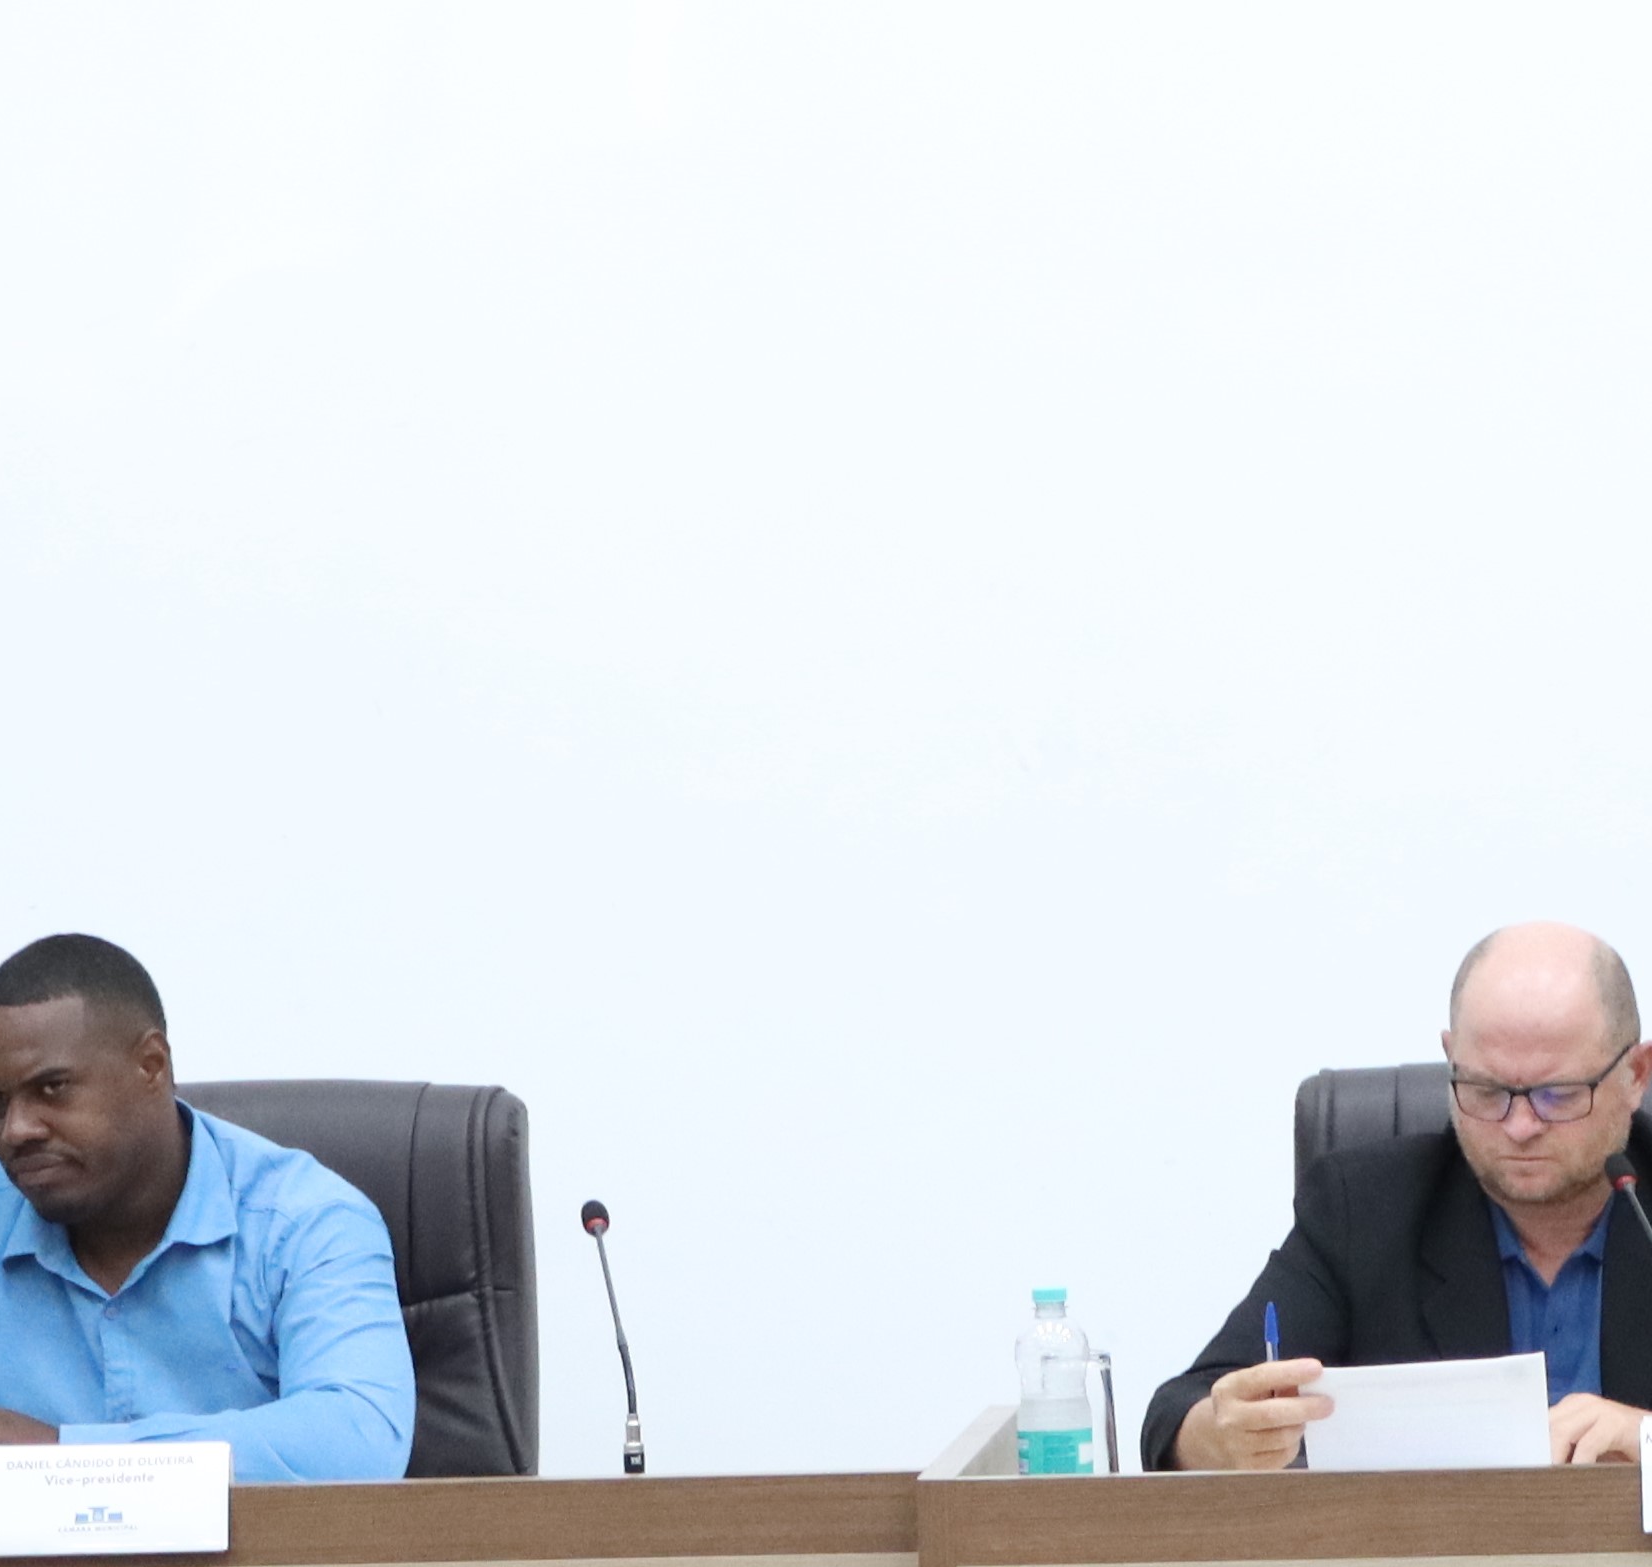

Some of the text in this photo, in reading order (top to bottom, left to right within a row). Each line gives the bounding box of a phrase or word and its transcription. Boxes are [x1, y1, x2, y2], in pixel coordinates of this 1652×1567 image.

[6, 1455, 194, 1471] DANIEL CÂNDIDO DE OLIVEIRA
[44, 1472, 155, 1487] Vice-presidente
